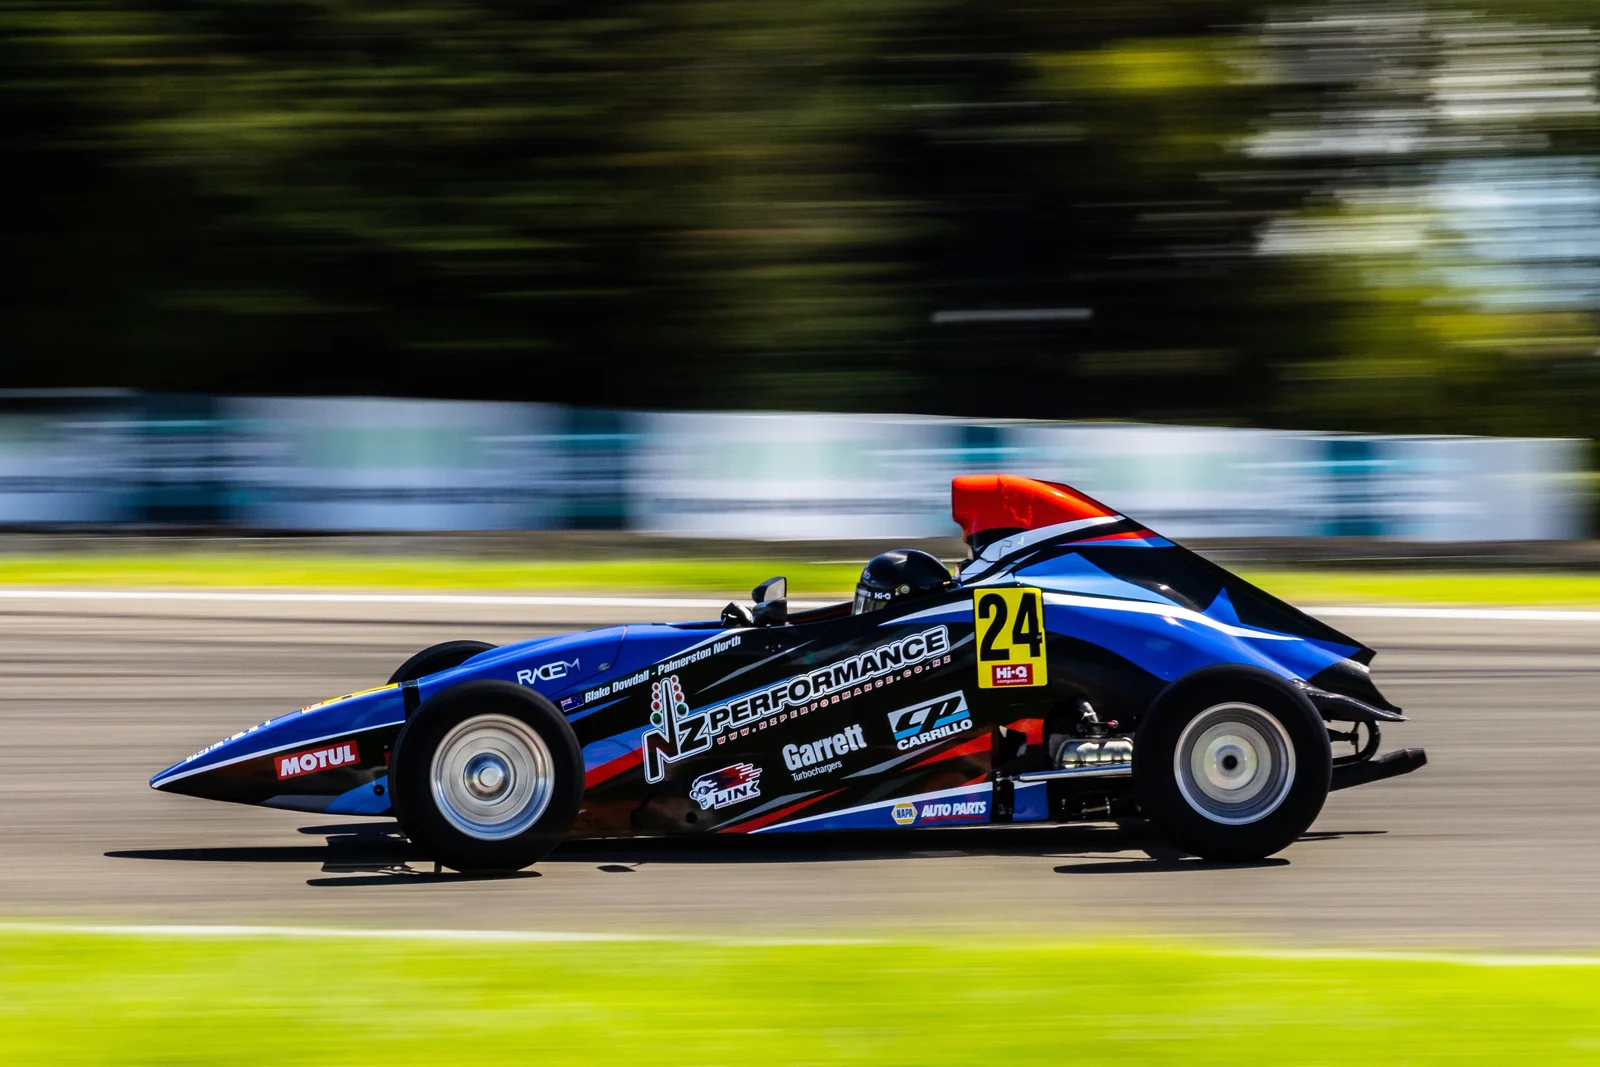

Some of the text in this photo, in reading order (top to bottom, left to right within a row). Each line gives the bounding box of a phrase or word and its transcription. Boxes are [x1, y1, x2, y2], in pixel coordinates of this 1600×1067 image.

[978, 592, 1043, 662] 24
[584, 686, 611, 703] Blake
[612, 669, 650, 693] Dowdall
[657, 648, 712, 676] Palmerston
[713, 635, 741, 655] North
[782, 723, 868, 772] Garrett
[896, 718, 973, 751] CARRILLO
[280, 744, 356, 777] MOTUL
[791, 759, 843, 782] Turbochargers
[714, 780, 760, 805] LINK
[896, 808, 914, 818] NAPA
[920, 801, 987, 818] AUTO PARTS
